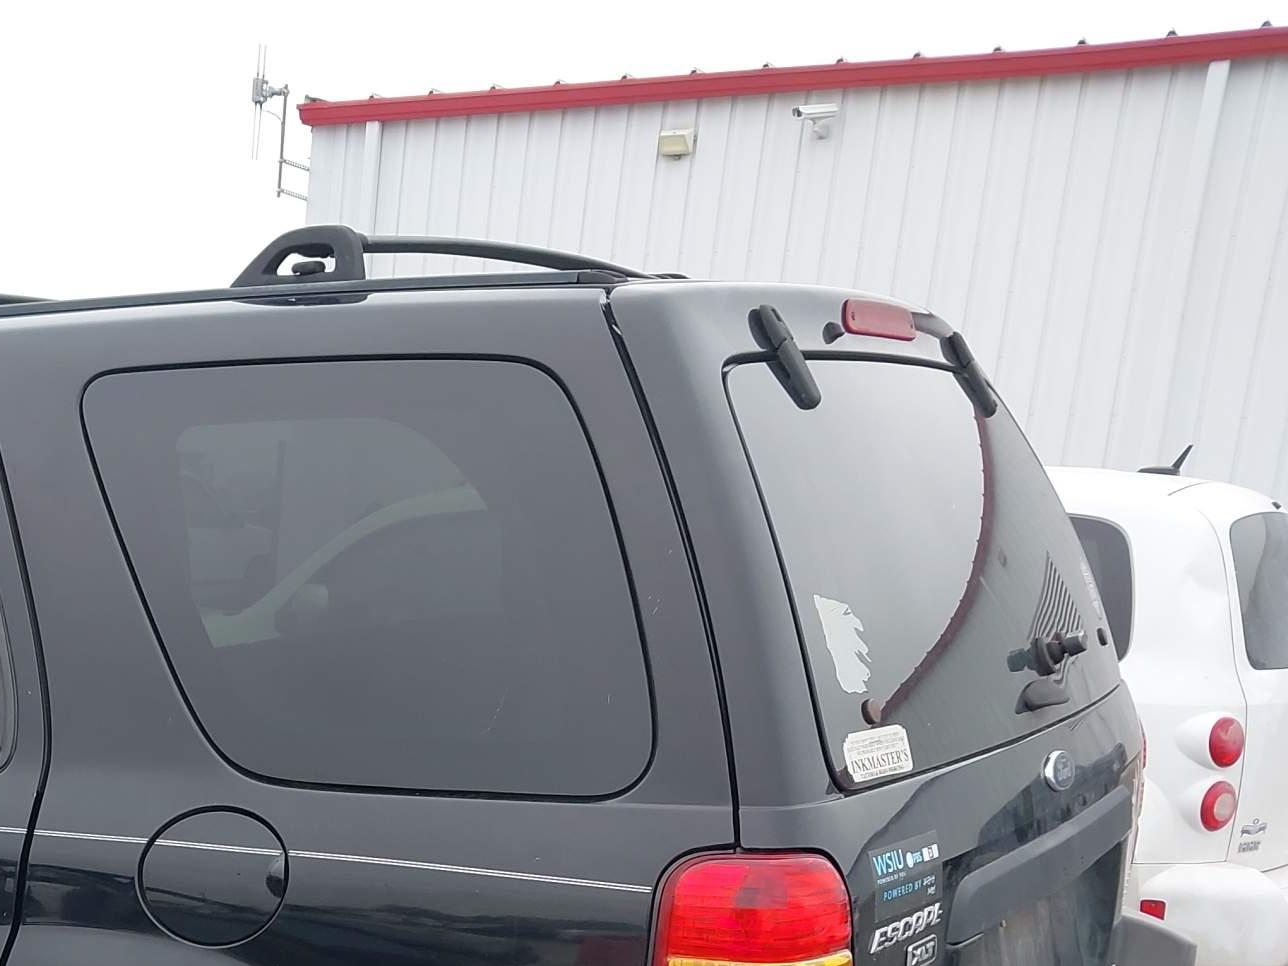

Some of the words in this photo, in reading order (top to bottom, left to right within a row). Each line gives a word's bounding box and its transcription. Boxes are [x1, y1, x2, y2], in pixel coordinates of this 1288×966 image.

[850, 748, 910, 775] INKMASTER'S
[872, 848, 904, 877] WSIU
[883, 882, 913, 902] POWERED
[869, 902, 943, 955] ESCAPE
